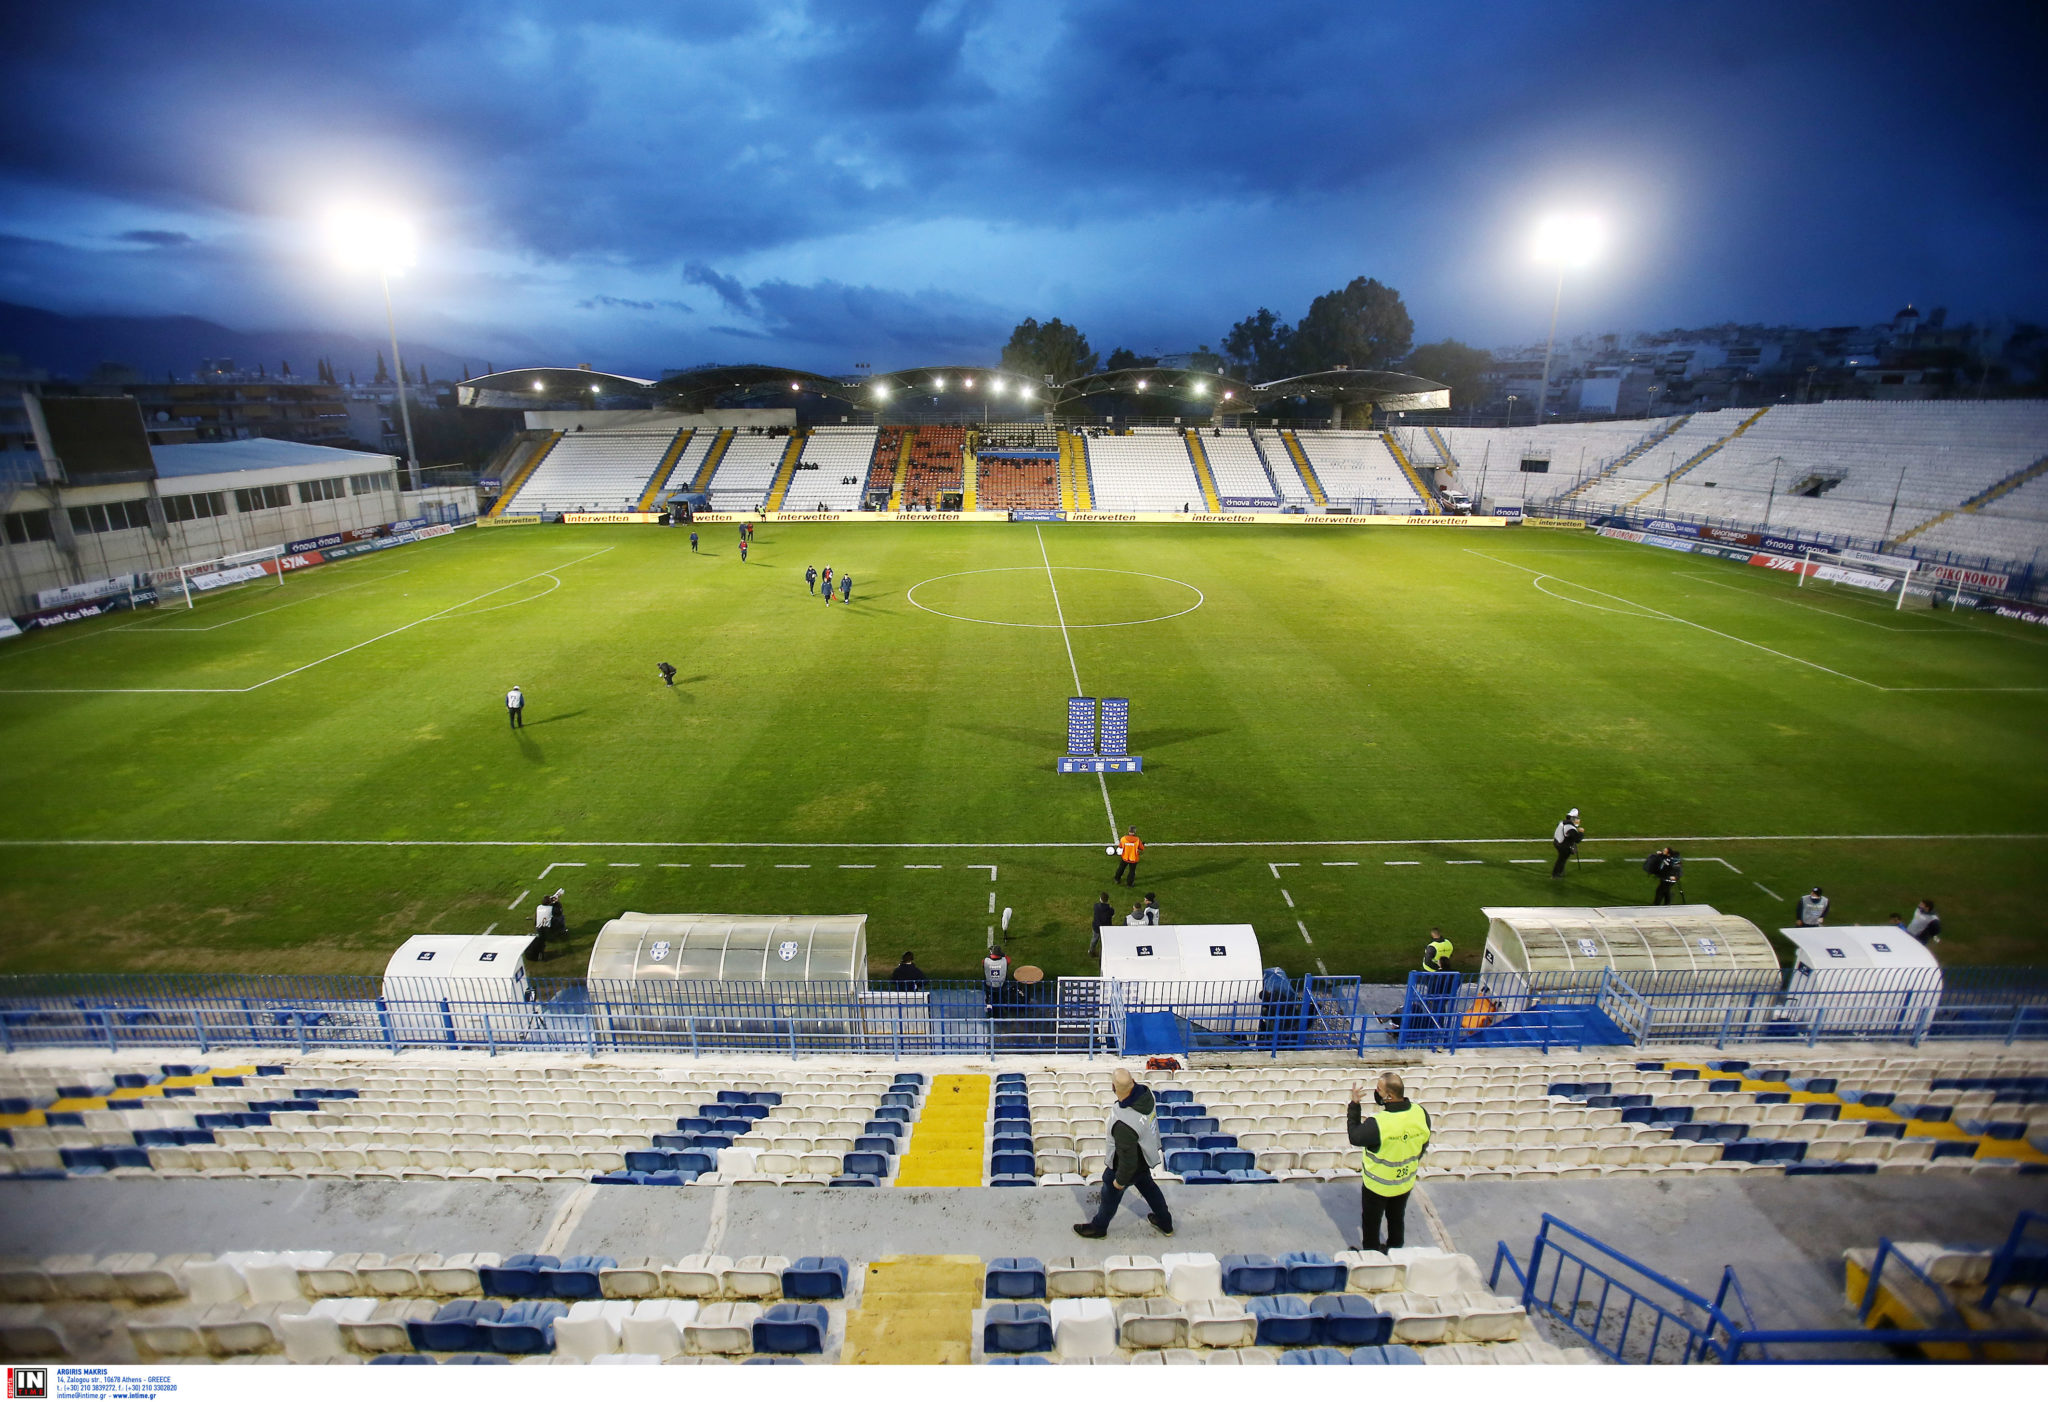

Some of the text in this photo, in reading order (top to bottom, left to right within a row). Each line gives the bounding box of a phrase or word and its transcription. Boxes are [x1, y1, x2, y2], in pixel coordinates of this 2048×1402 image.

[494, 516, 538, 525] interwetten
[567, 514, 629, 522] interwetten
[777, 513, 840, 521] interwetten
[896, 513, 960, 521] interwetten
[1072, 513, 1136, 521] interwetten
[1192, 514, 1255, 522] interwetten
[1304, 515, 1366, 523] interwetten
[1406, 516, 1468, 525] interwetten
[1538, 519, 1582, 528] interwetten
[1648, 520, 1676, 531] ARENA
[300, 536, 341, 550] nova nova
[1772, 539, 1829, 555] nova nova
[1856, 552, 1874, 562] Ermis
[281, 555, 309, 569] SYM
[1765, 557, 1796, 571] SYM
[38, 613, 65, 627] Dent
[64, 608, 81, 620] Car
[80, 605, 102, 617] Hall
[1995, 606, 2021, 619] Dent
[2021, 612, 2039, 622] Car
